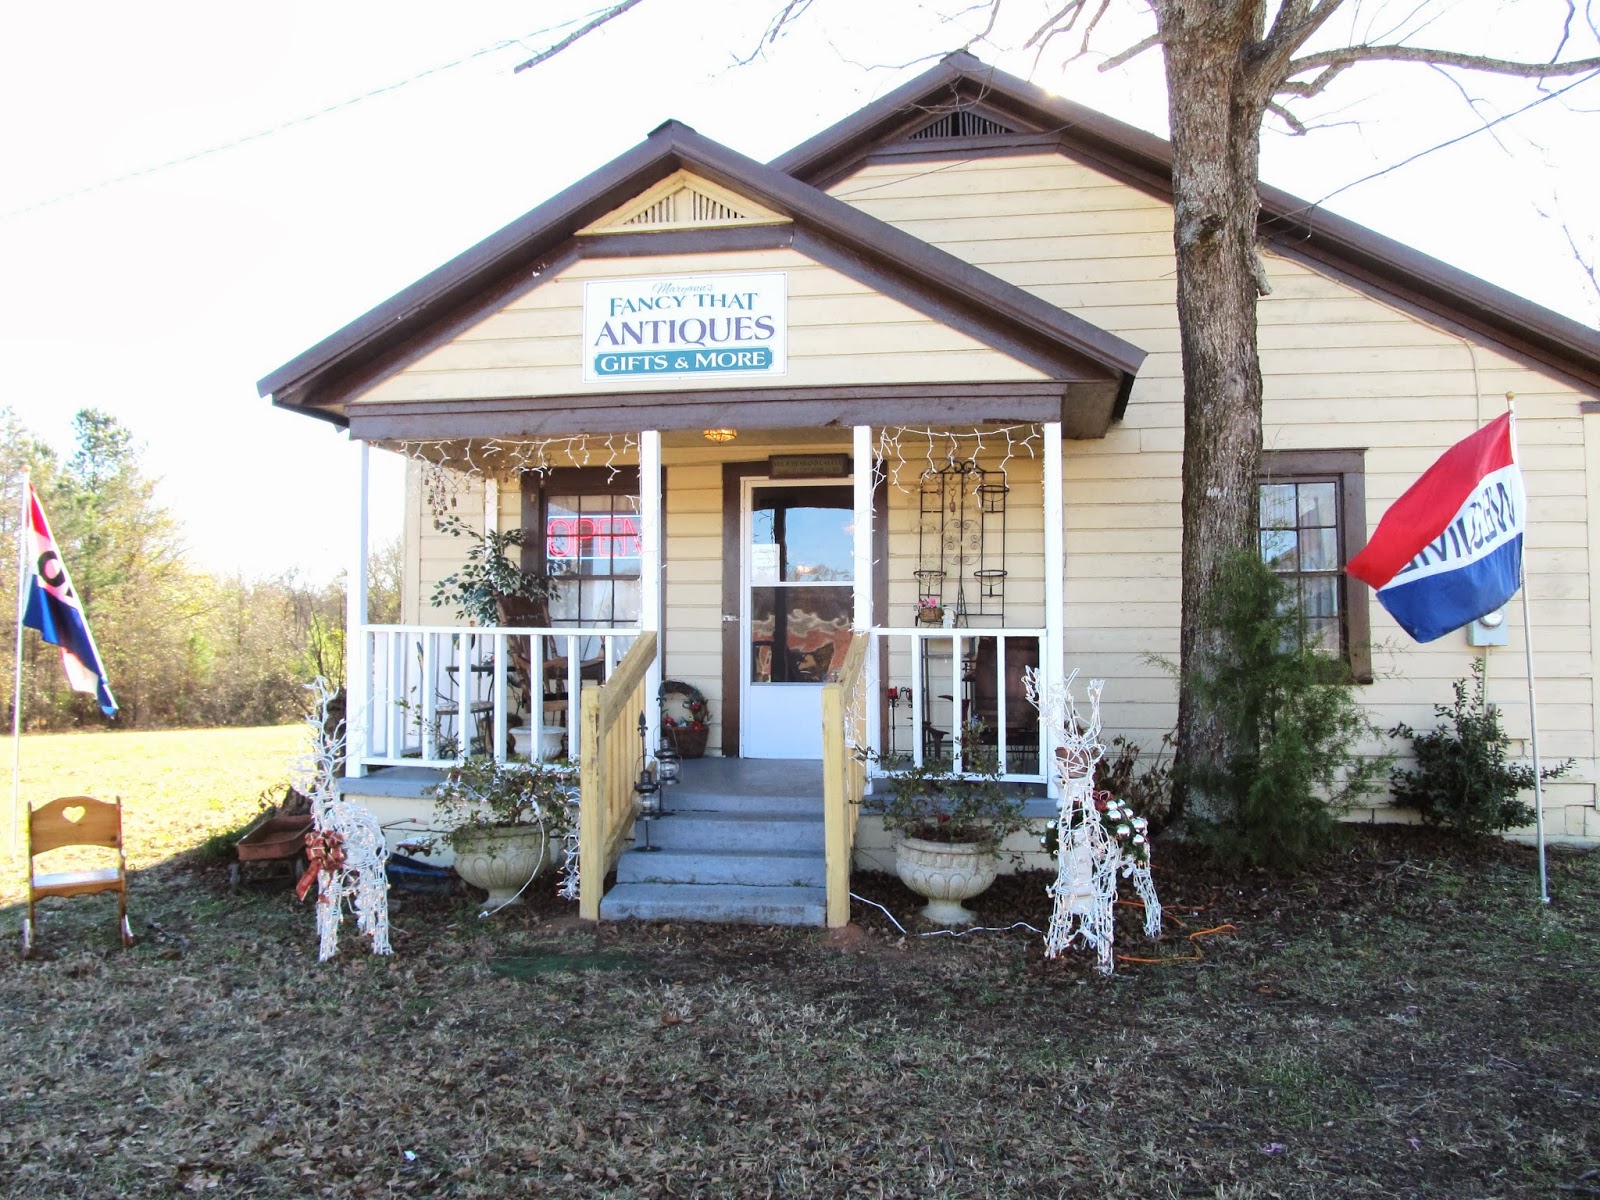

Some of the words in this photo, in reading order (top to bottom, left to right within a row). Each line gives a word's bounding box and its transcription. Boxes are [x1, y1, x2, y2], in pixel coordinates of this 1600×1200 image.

[609, 295, 686, 317] FANCY
[692, 292, 759, 311] THAT
[593, 315, 776, 349] ANTIQUES
[600, 354, 669, 372] GIFTS
[674, 356, 690, 370] &
[694, 351, 767, 368] MORE
[548, 518, 643, 557] OPEN
